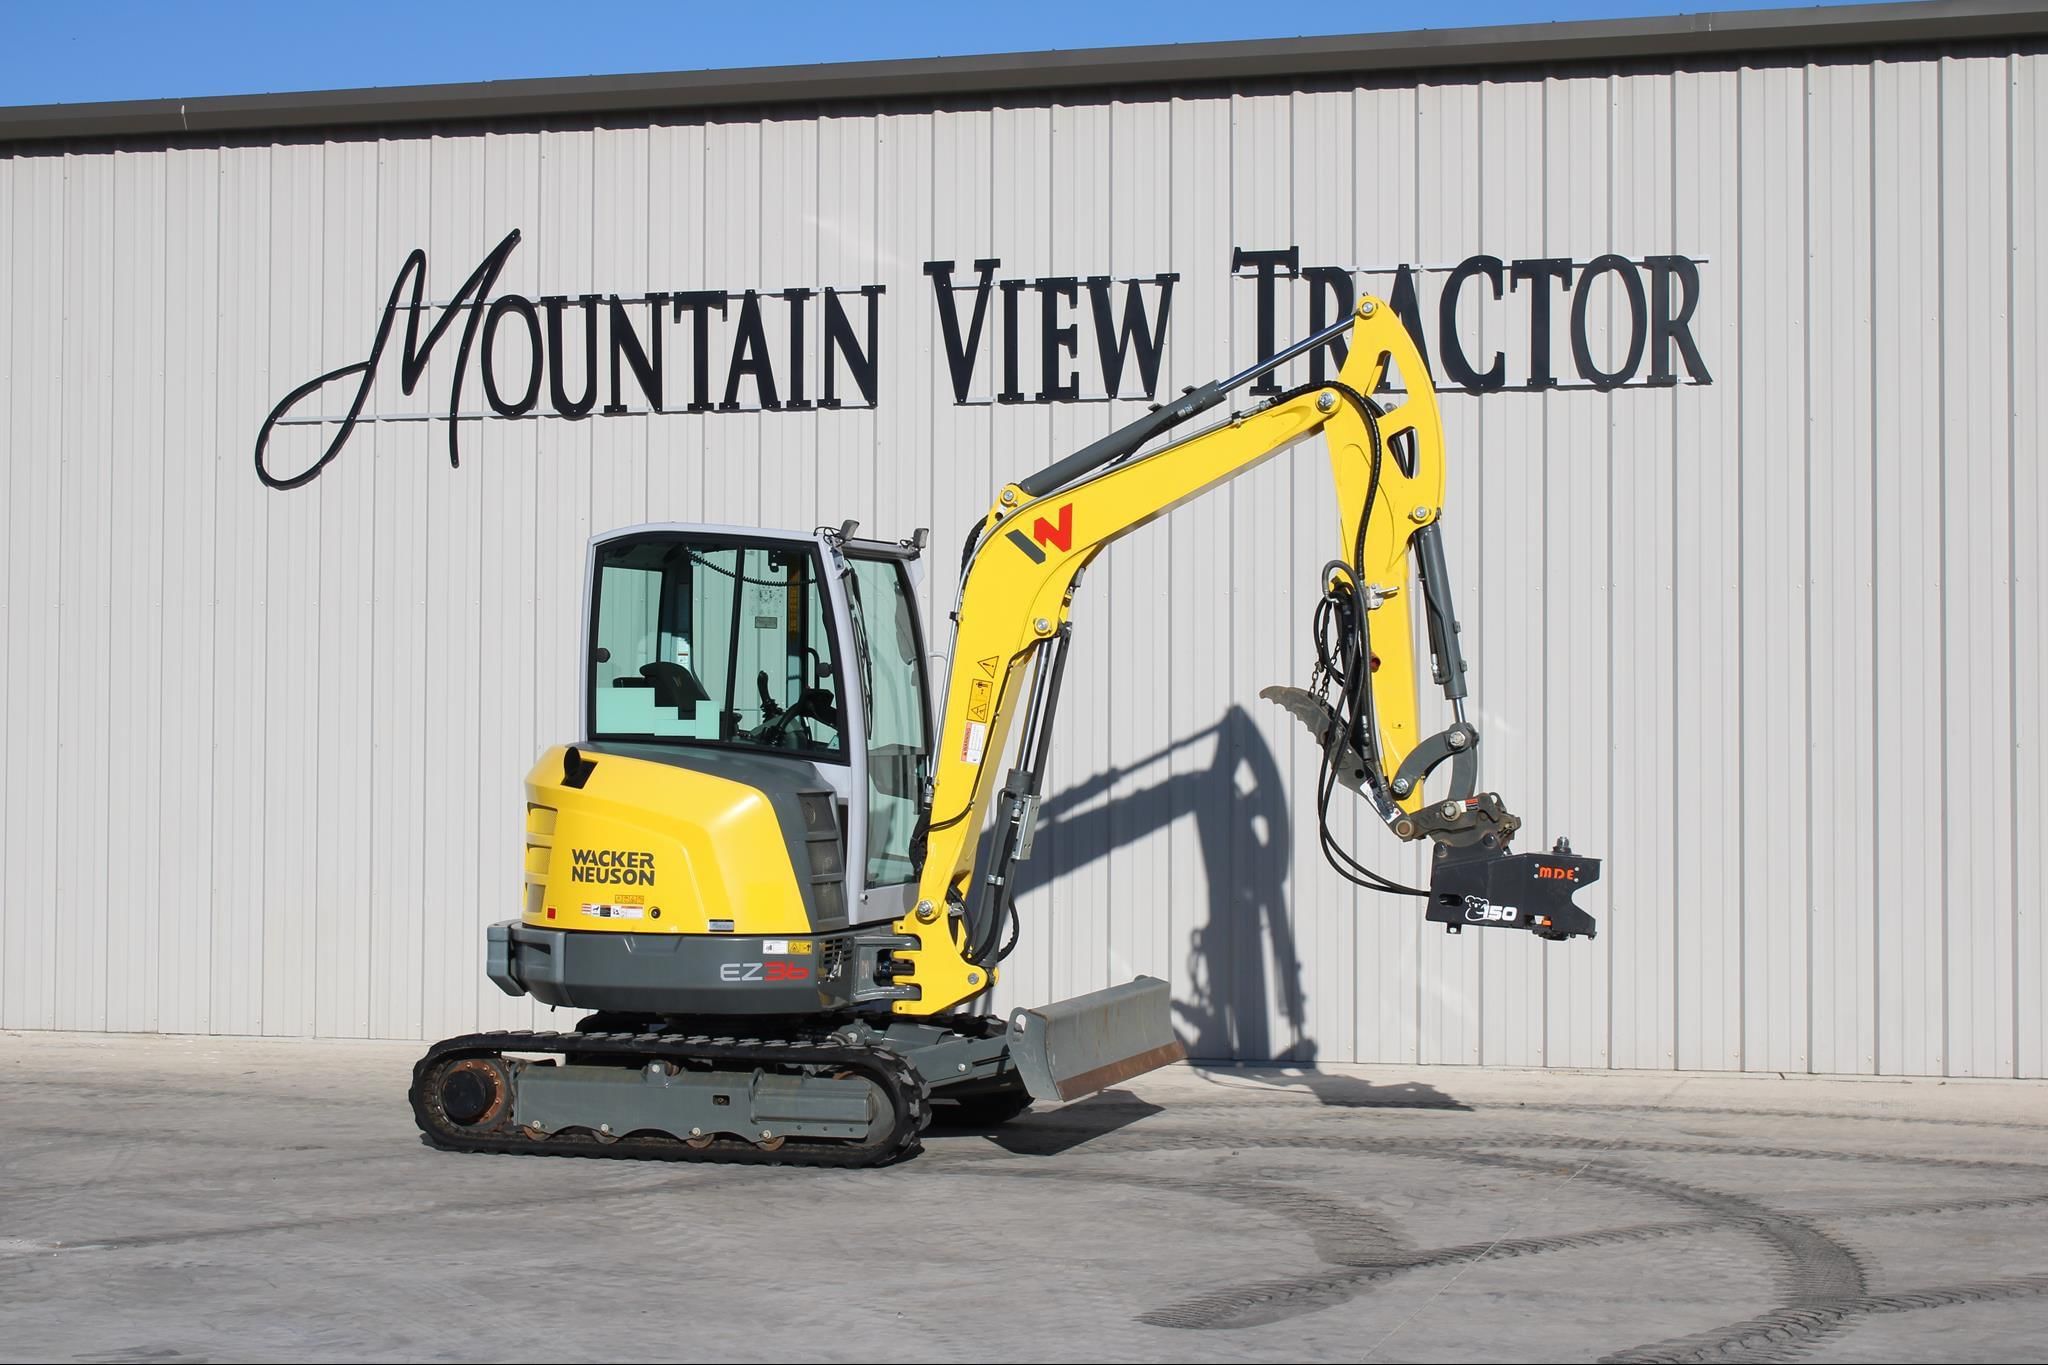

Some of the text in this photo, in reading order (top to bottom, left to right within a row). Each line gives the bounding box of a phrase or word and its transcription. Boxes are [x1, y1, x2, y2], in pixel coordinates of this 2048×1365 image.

[254, 228, 886, 490] MOUNTAIN
[923, 258, 1180, 404] VIEW
[571, 849, 655, 869] WACKER
[571, 866, 655, 886] NEUSON
[1538, 866, 1575, 880] MDE
